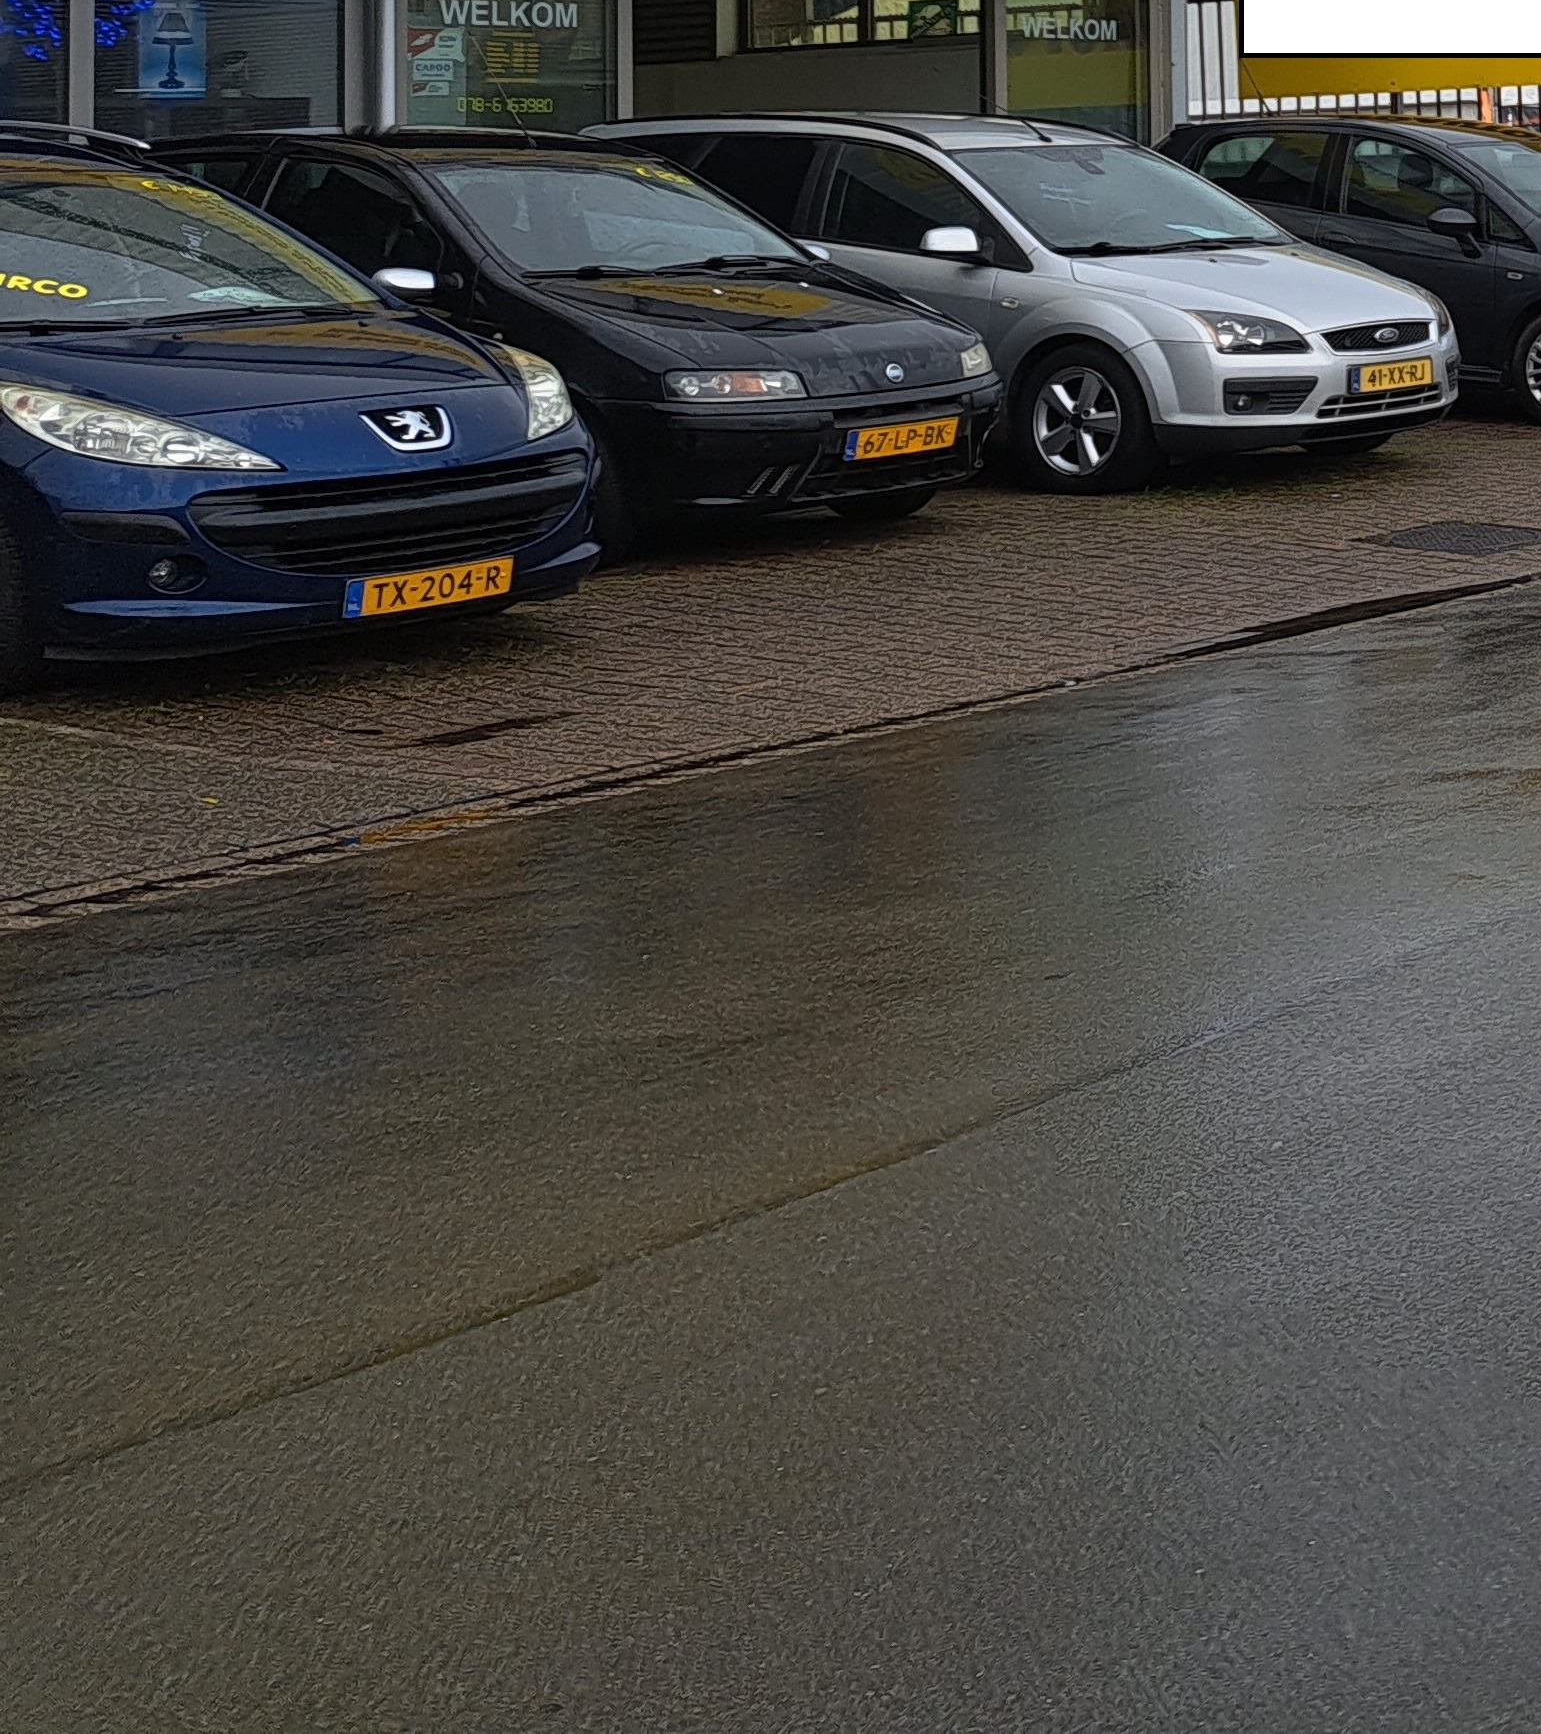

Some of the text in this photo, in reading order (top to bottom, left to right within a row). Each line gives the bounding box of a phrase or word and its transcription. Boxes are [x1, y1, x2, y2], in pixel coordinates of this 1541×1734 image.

[1021, 15, 1118, 41] WELKOM
[1367, 363, 1426, 387] 41-XX-RJ
[863, 423, 951, 454] 67-LP-BK
[372, 566, 501, 609] TX-204-R
